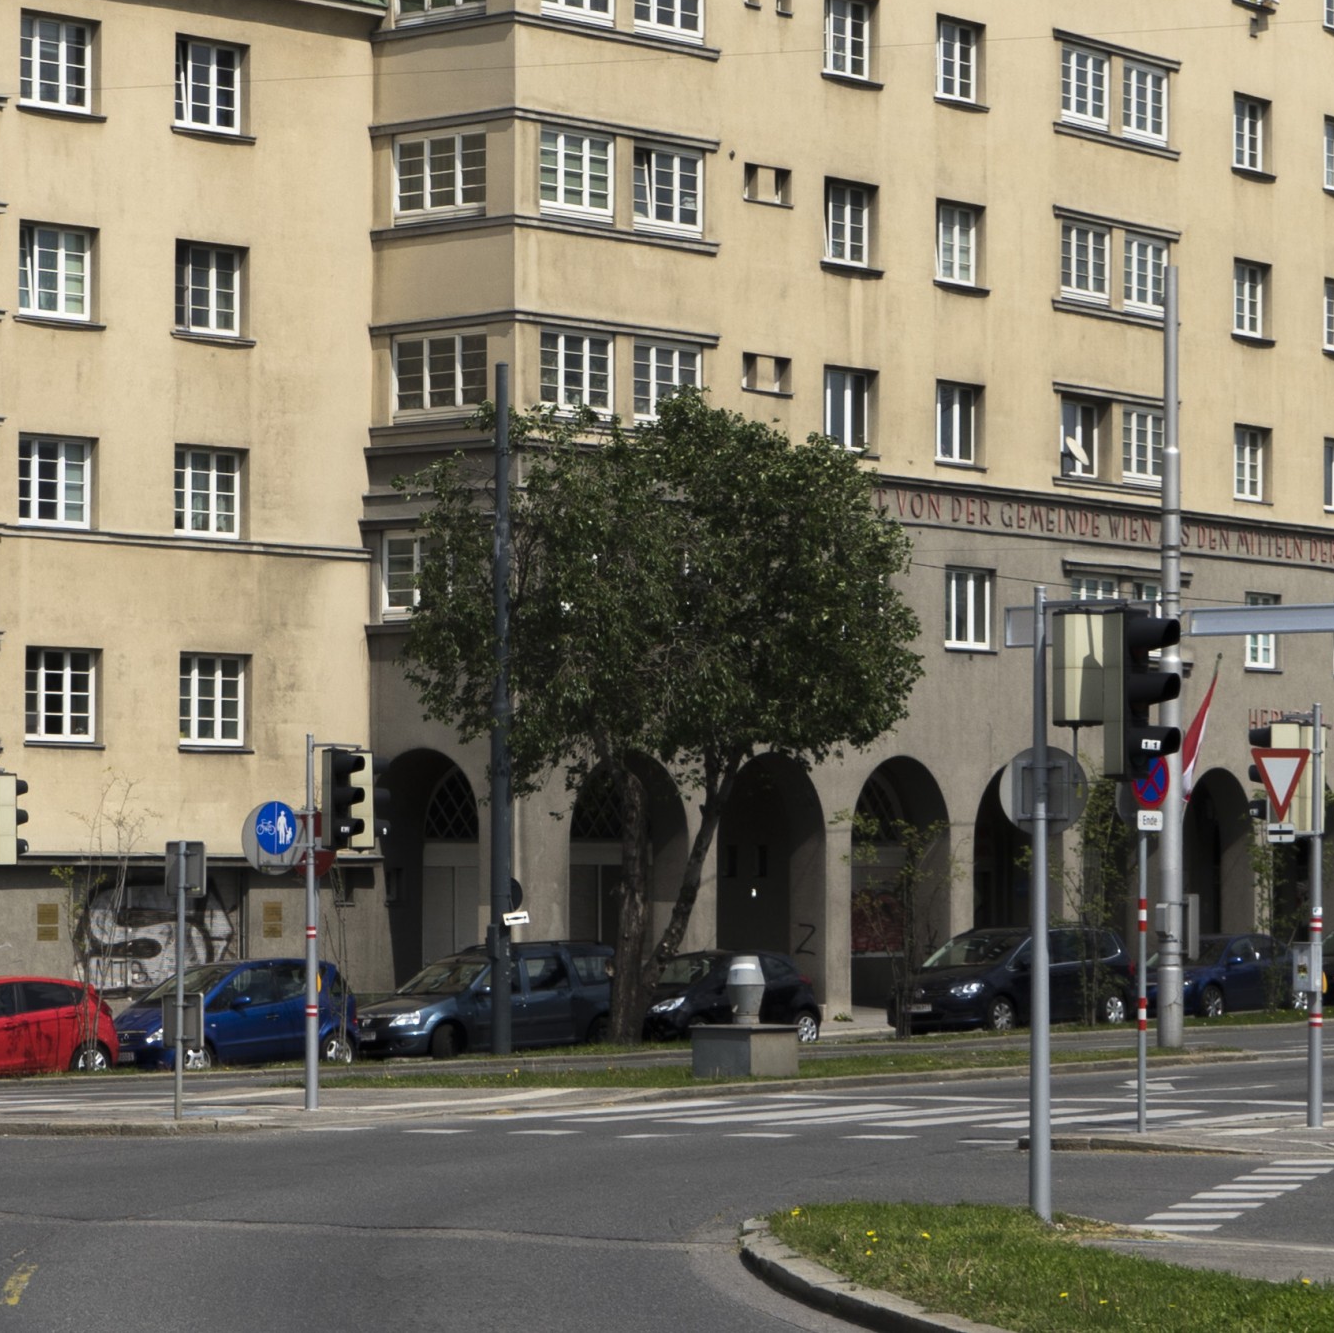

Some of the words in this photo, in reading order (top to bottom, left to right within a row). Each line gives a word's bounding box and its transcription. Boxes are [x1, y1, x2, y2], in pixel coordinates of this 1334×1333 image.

[896, 489, 940, 519] VON
[952, 496, 992, 526] DER
[1001, 501, 1100, 538] GEMEINDE
[1108, 514, 1153, 542] WIEN
[1198, 523, 1230, 551] DEN
[1236, 529, 1303, 560] MITTELN
[1142, 814, 1158, 826] Ende
